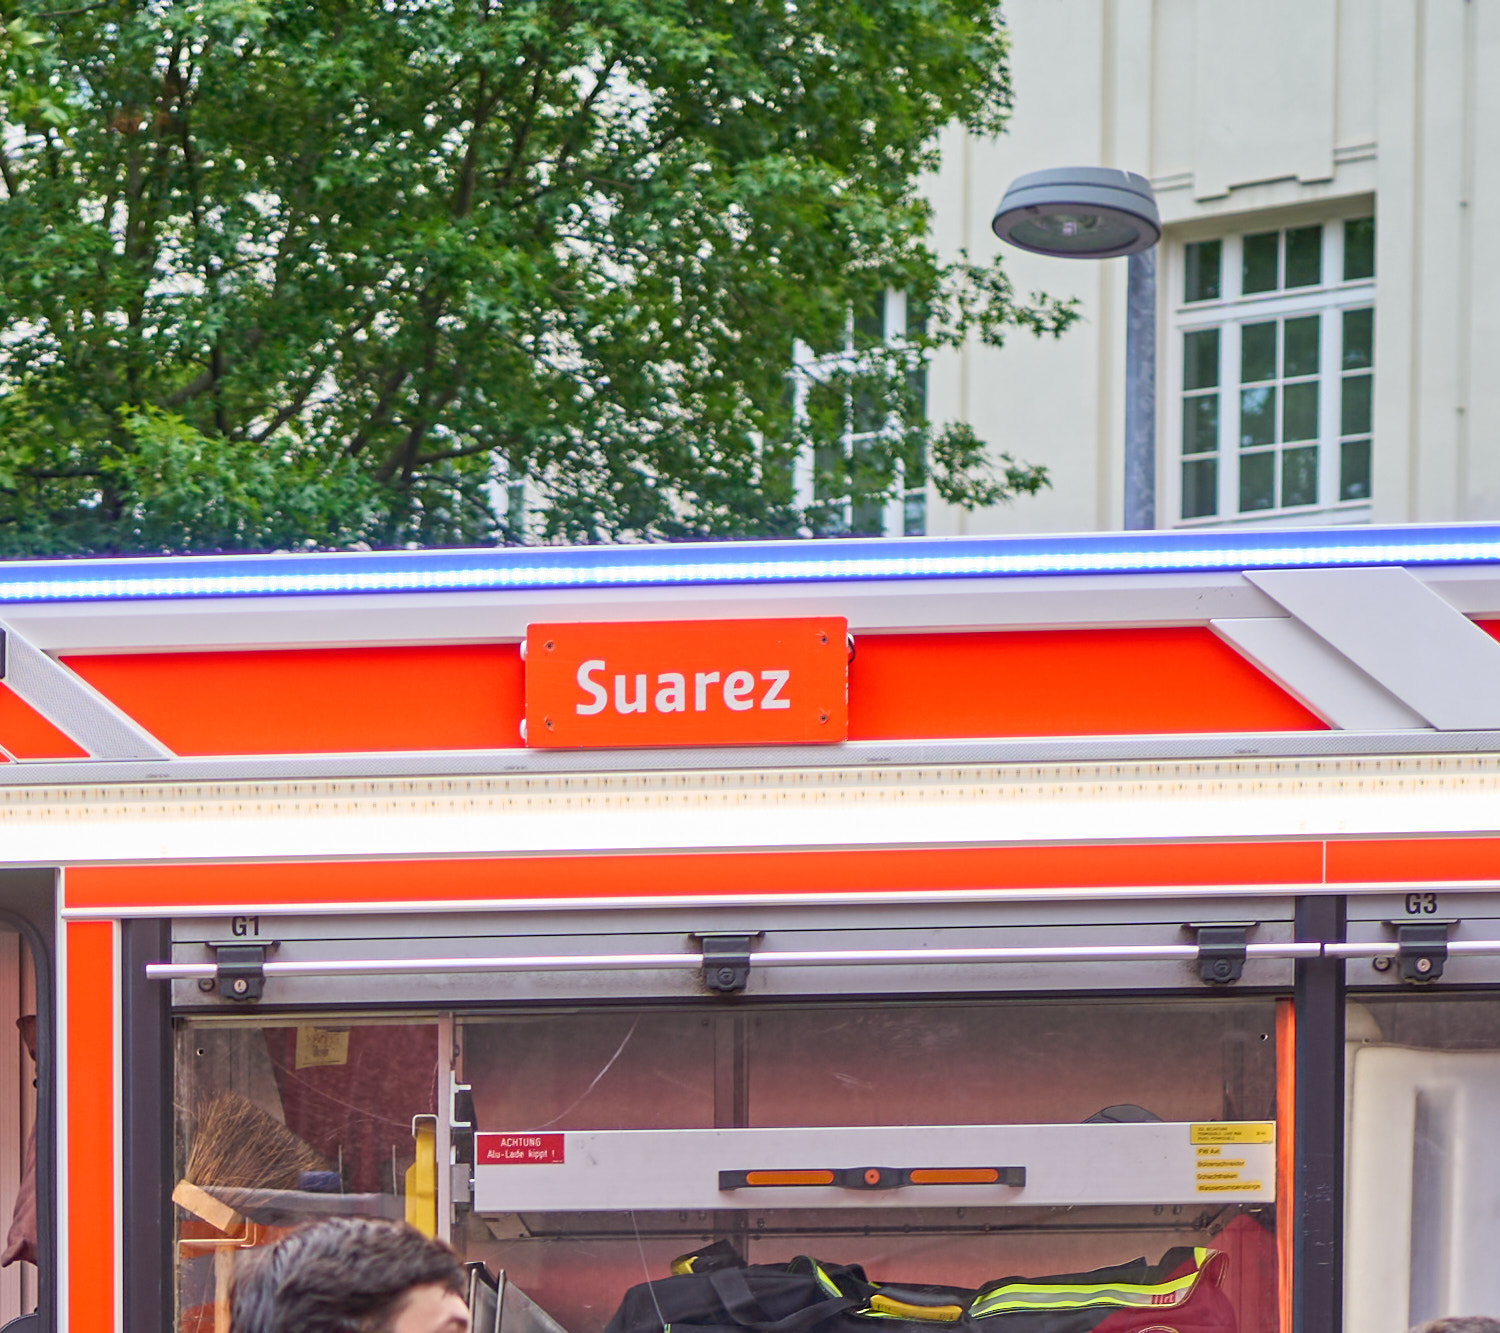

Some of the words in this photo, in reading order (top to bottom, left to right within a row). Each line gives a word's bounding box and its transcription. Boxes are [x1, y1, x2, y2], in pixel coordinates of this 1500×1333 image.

[575, 659, 791, 716] Suarez
[1405, 892, 1437, 914] G3
[232, 916, 260, 937] G1
[500, 1137, 541, 1147] ACHTUNG
[528, 1149, 548, 1160] kippt
